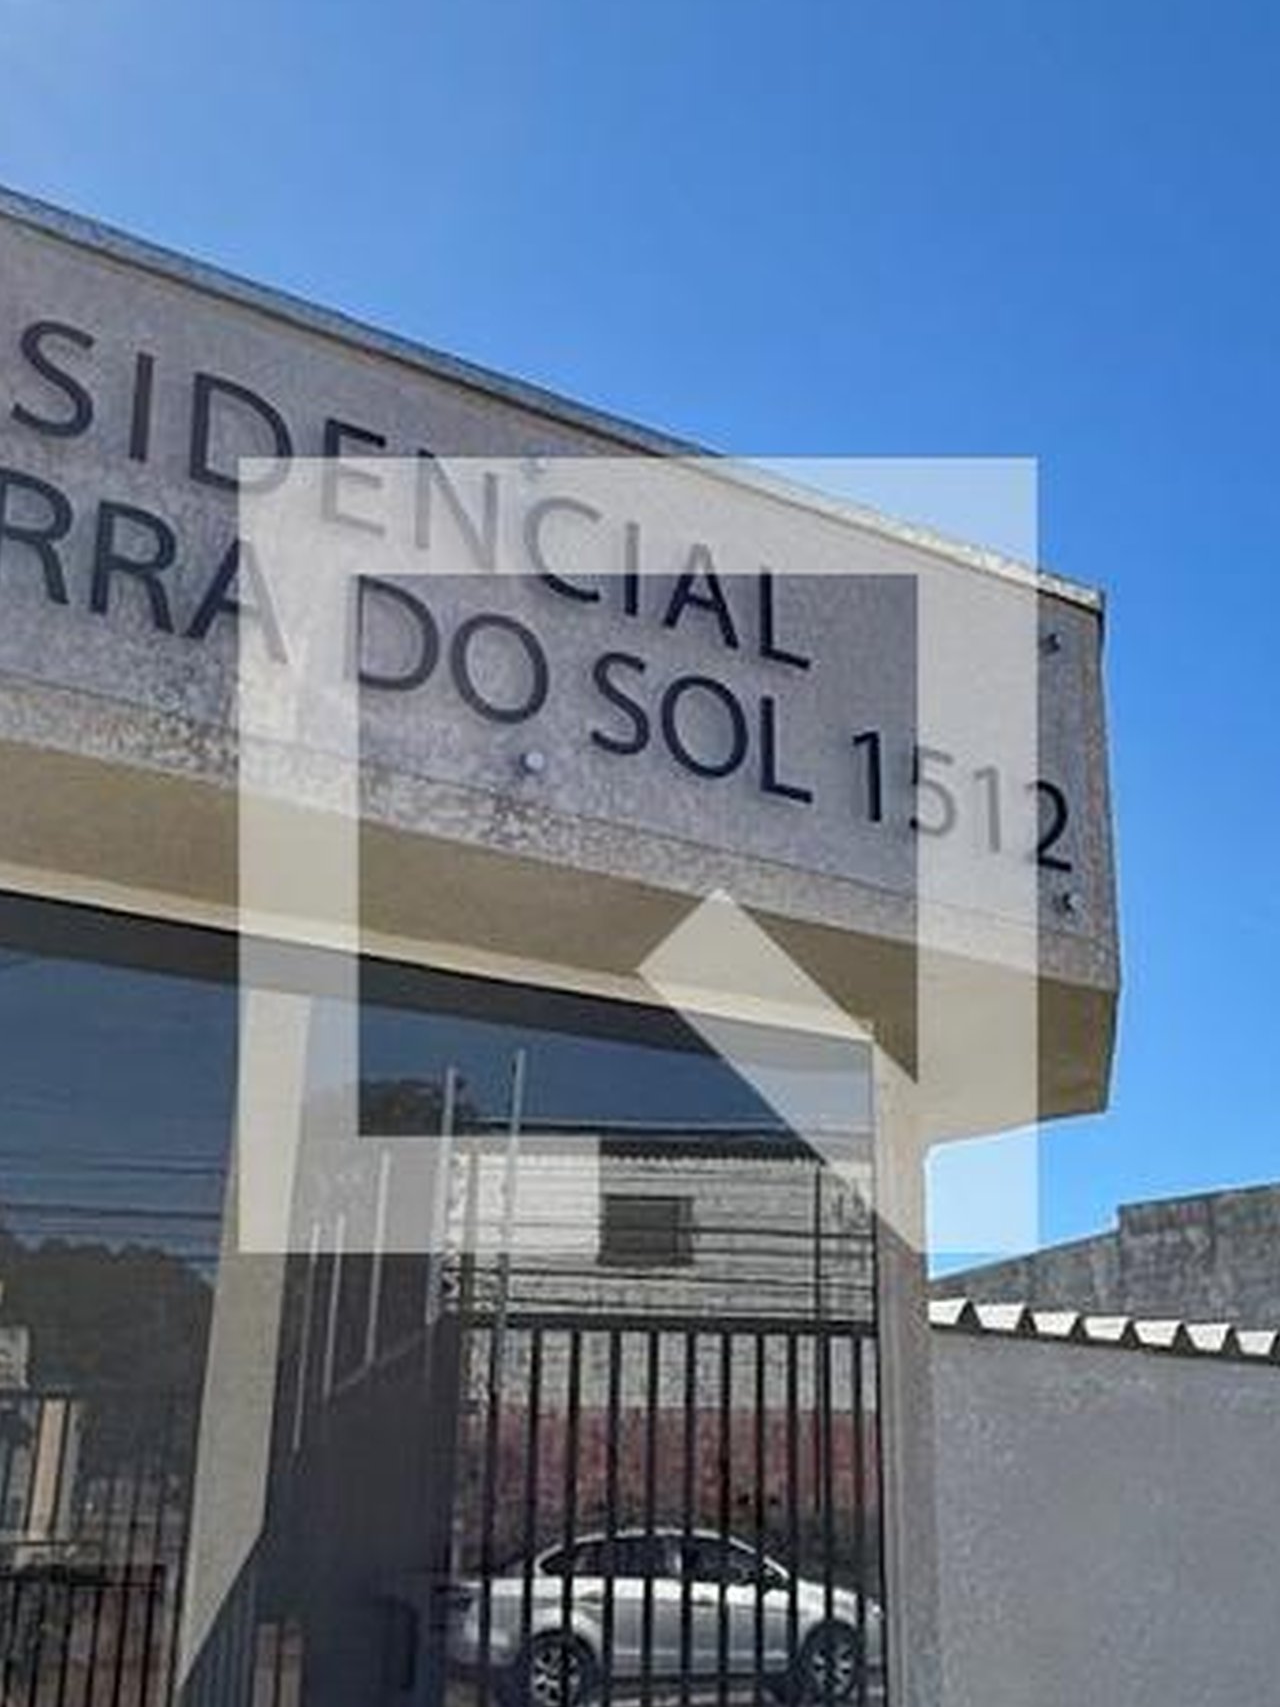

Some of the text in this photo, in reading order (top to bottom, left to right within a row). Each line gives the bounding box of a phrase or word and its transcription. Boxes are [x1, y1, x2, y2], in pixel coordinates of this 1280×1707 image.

[350, 574, 550, 725] DO
[589, 651, 813, 805] SOL
[850, 729, 1073, 873] 1512
